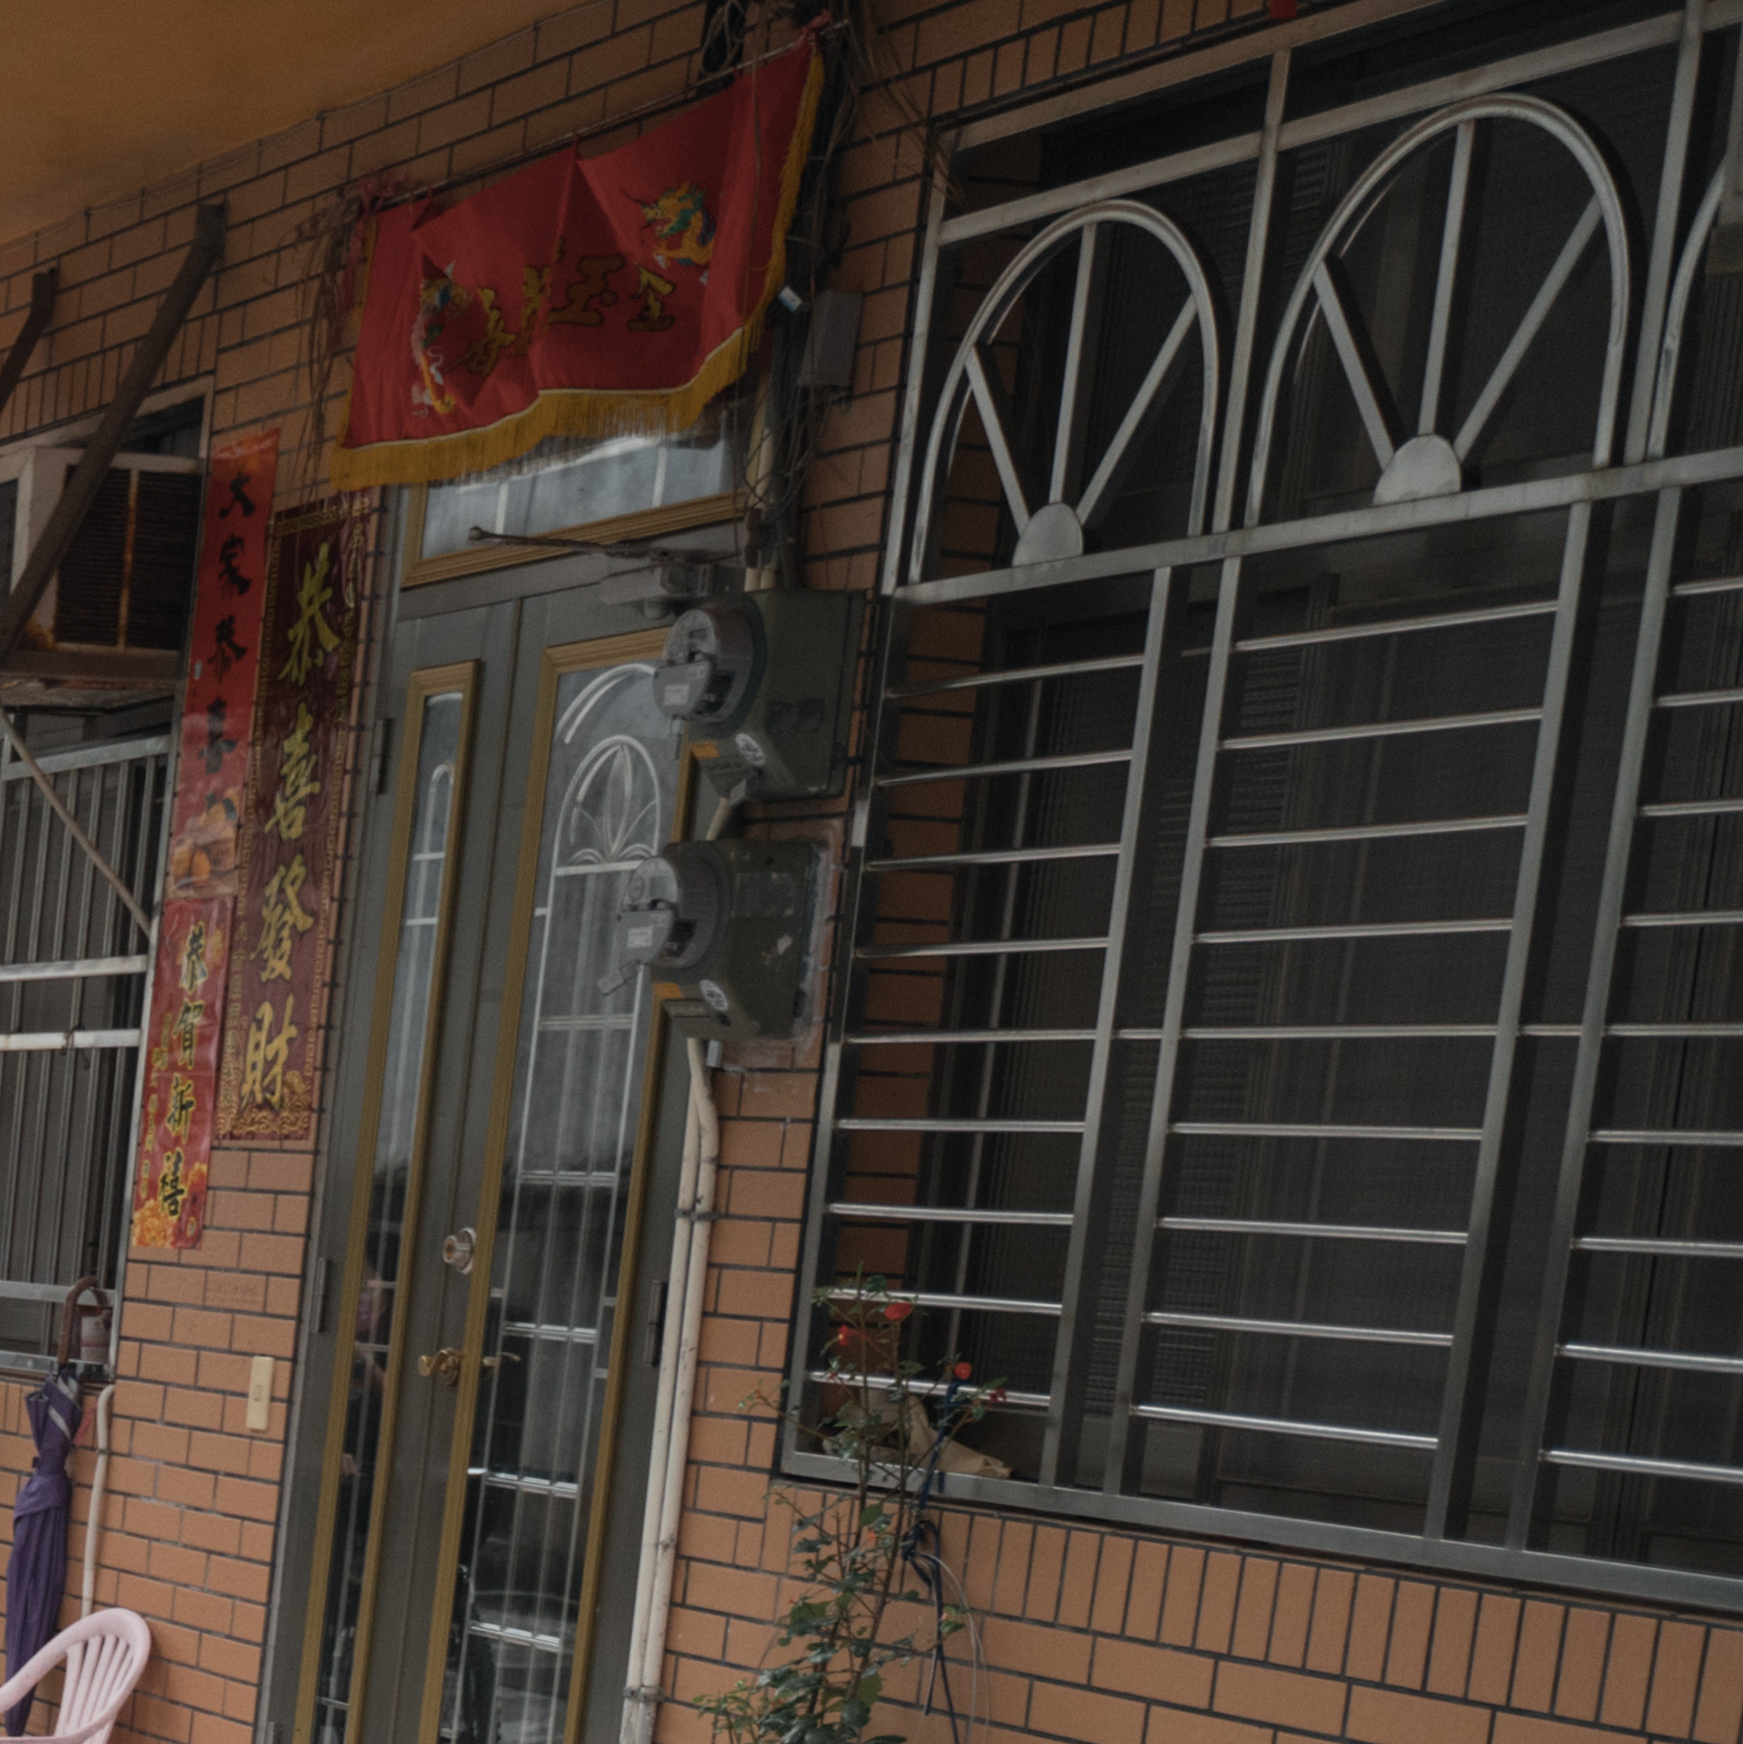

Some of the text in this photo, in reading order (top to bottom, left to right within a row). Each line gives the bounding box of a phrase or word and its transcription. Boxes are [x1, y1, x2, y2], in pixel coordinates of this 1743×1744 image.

[240, 542, 341, 1111] 恭喜發財
[158, 920, 210, 1219] 恭賀新禧
